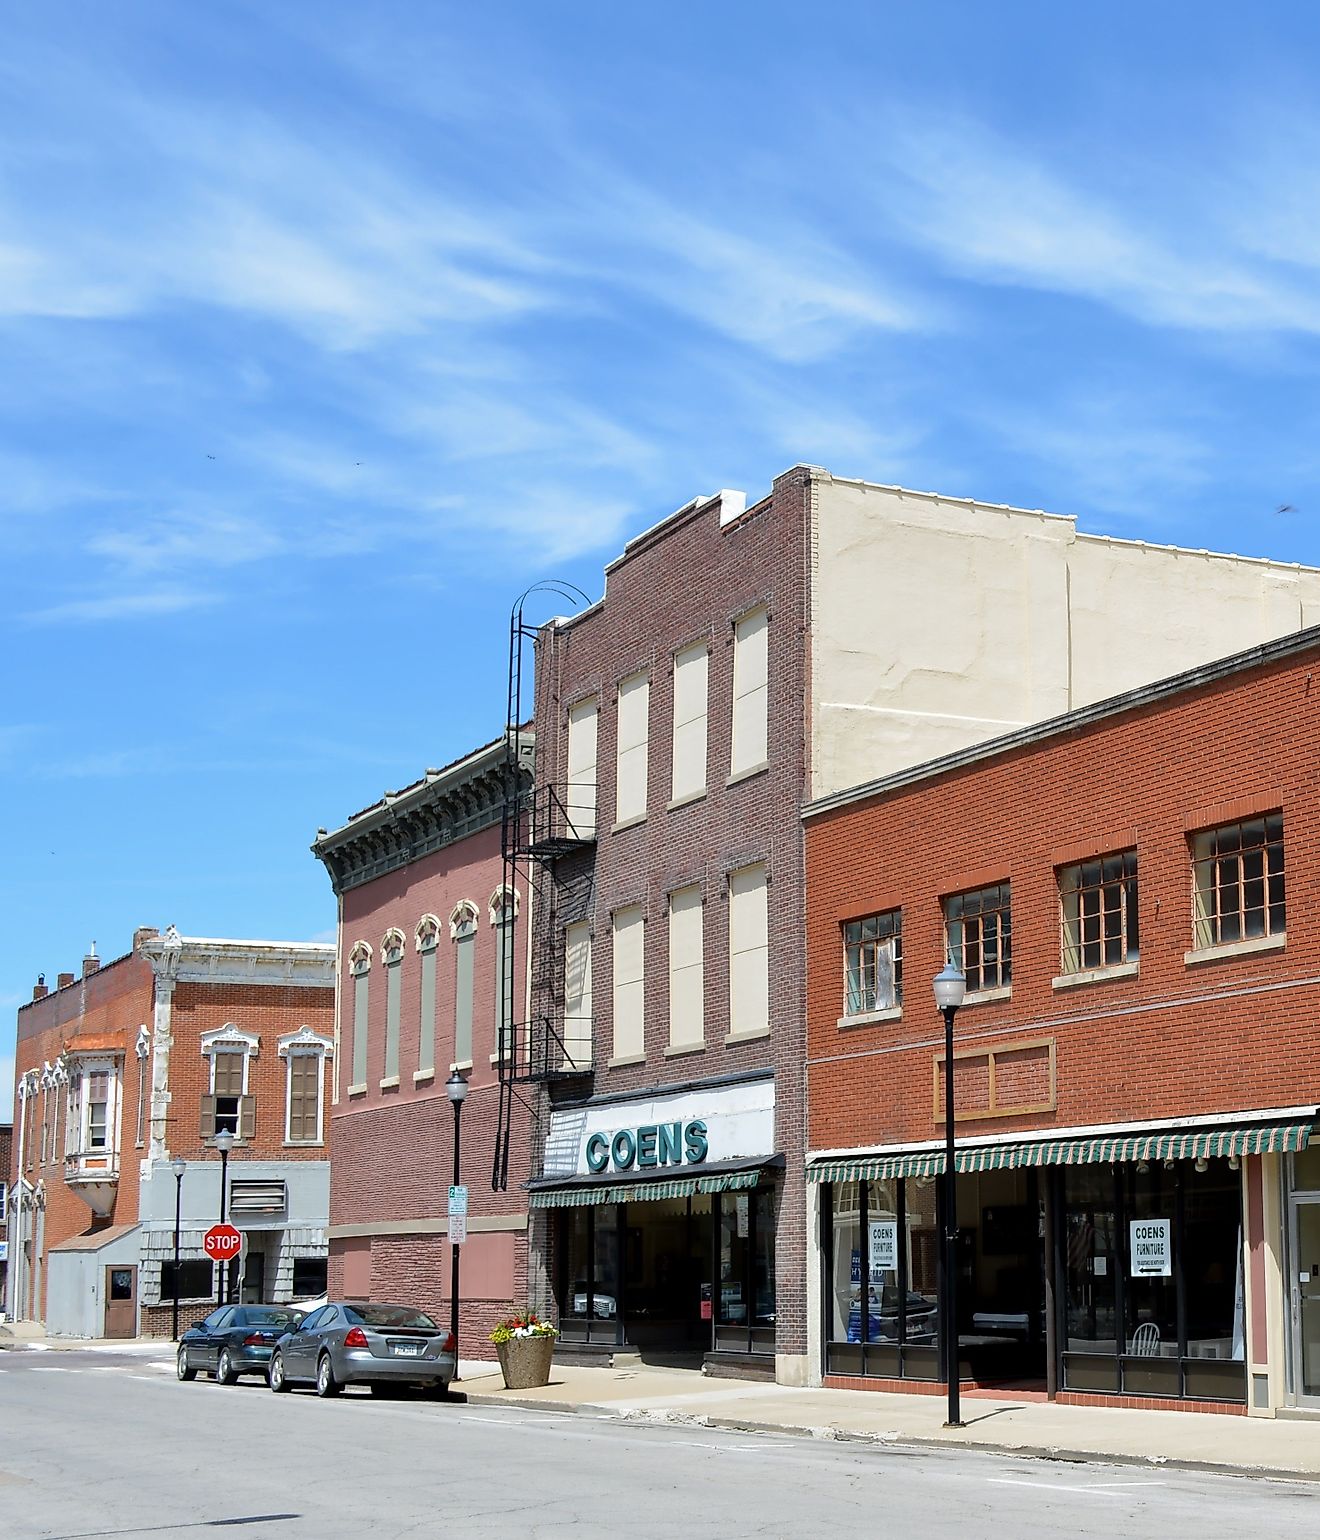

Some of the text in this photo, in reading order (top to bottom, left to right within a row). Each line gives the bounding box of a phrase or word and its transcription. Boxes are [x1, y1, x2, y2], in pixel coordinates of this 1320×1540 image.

[586, 1119, 709, 1172] COENS
[872, 1228, 893, 1239] COENS
[1135, 1226, 1165, 1239] COENS
[206, 1235, 240, 1250] STOP
[1136, 1243, 1164, 1255] FURNITURE
